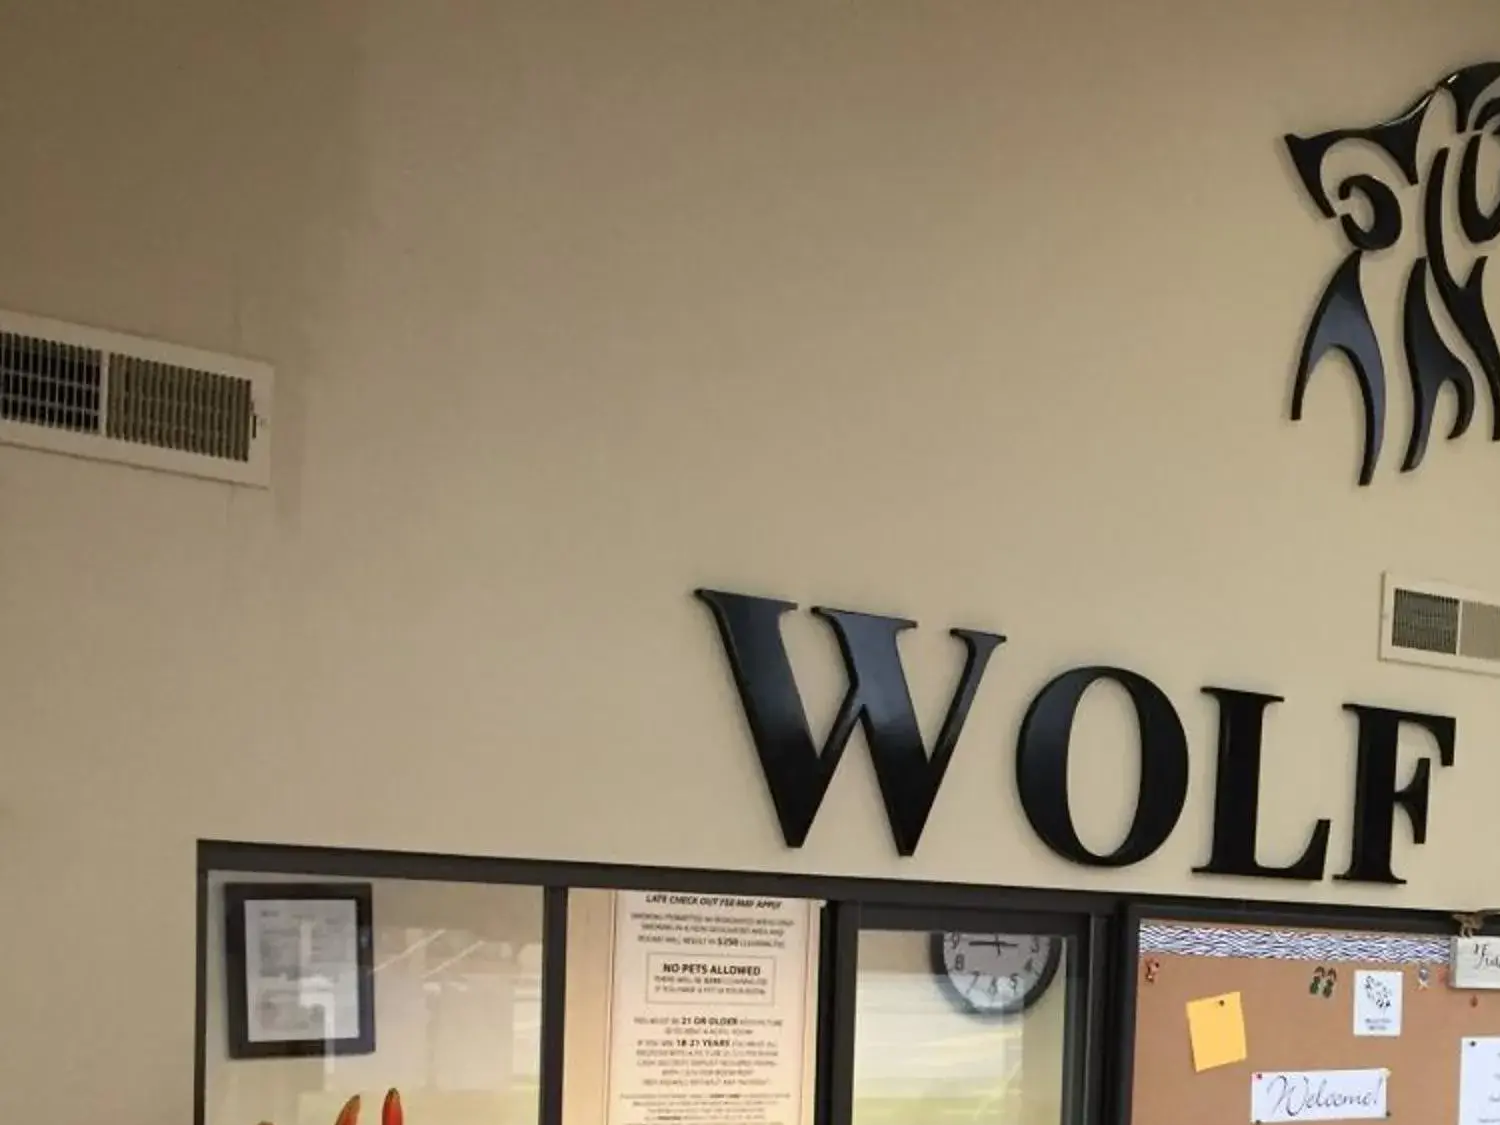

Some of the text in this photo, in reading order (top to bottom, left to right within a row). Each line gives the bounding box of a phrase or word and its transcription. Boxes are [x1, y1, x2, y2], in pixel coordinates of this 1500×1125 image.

[694, 588, 1456, 886] WOLF
[646, 893, 667, 904] LATE
[669, 894, 698, 905] CHECK
[700, 897, 718, 907] OUT
[756, 900, 783, 910] APPLY
[663, 963, 761, 976] NO PETS ALLOWED
[954, 953, 965, 971] 8
[966, 971, 981, 995] 7
[682, 1017, 692, 1025] 21
[694, 1017, 706, 1026] OR
[708, 1017, 738, 1026] OLDER
[702, 1038, 731, 1047] YEARS
[1266, 1073, 1379, 1117] Welcome!
